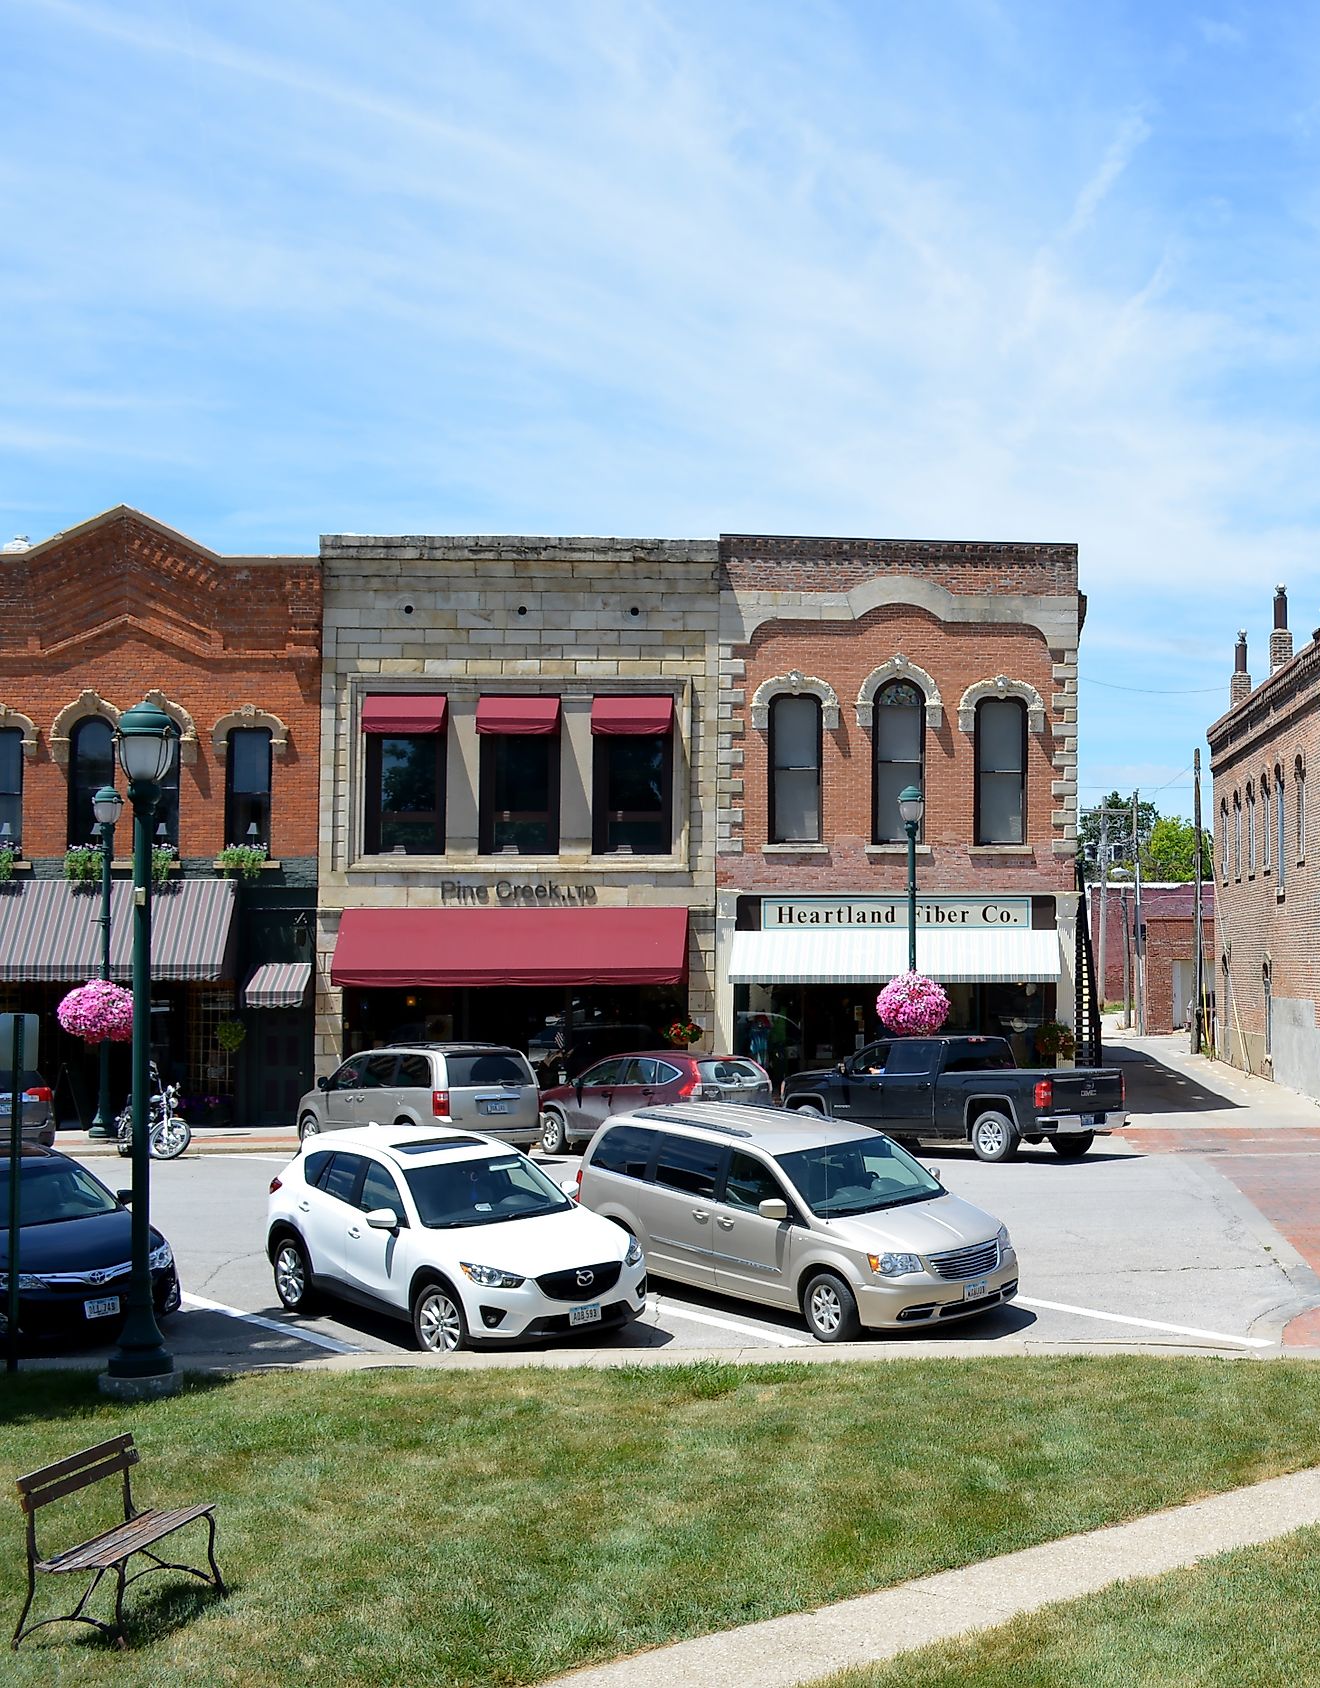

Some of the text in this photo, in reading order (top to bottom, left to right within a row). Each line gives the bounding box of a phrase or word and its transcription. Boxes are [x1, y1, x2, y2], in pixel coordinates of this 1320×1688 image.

[440, 880, 488, 900] Pine
[777, 905, 896, 924] Heartland
[981, 904, 1018, 924] Co.
[1080, 1089, 1097, 1097] GMC
